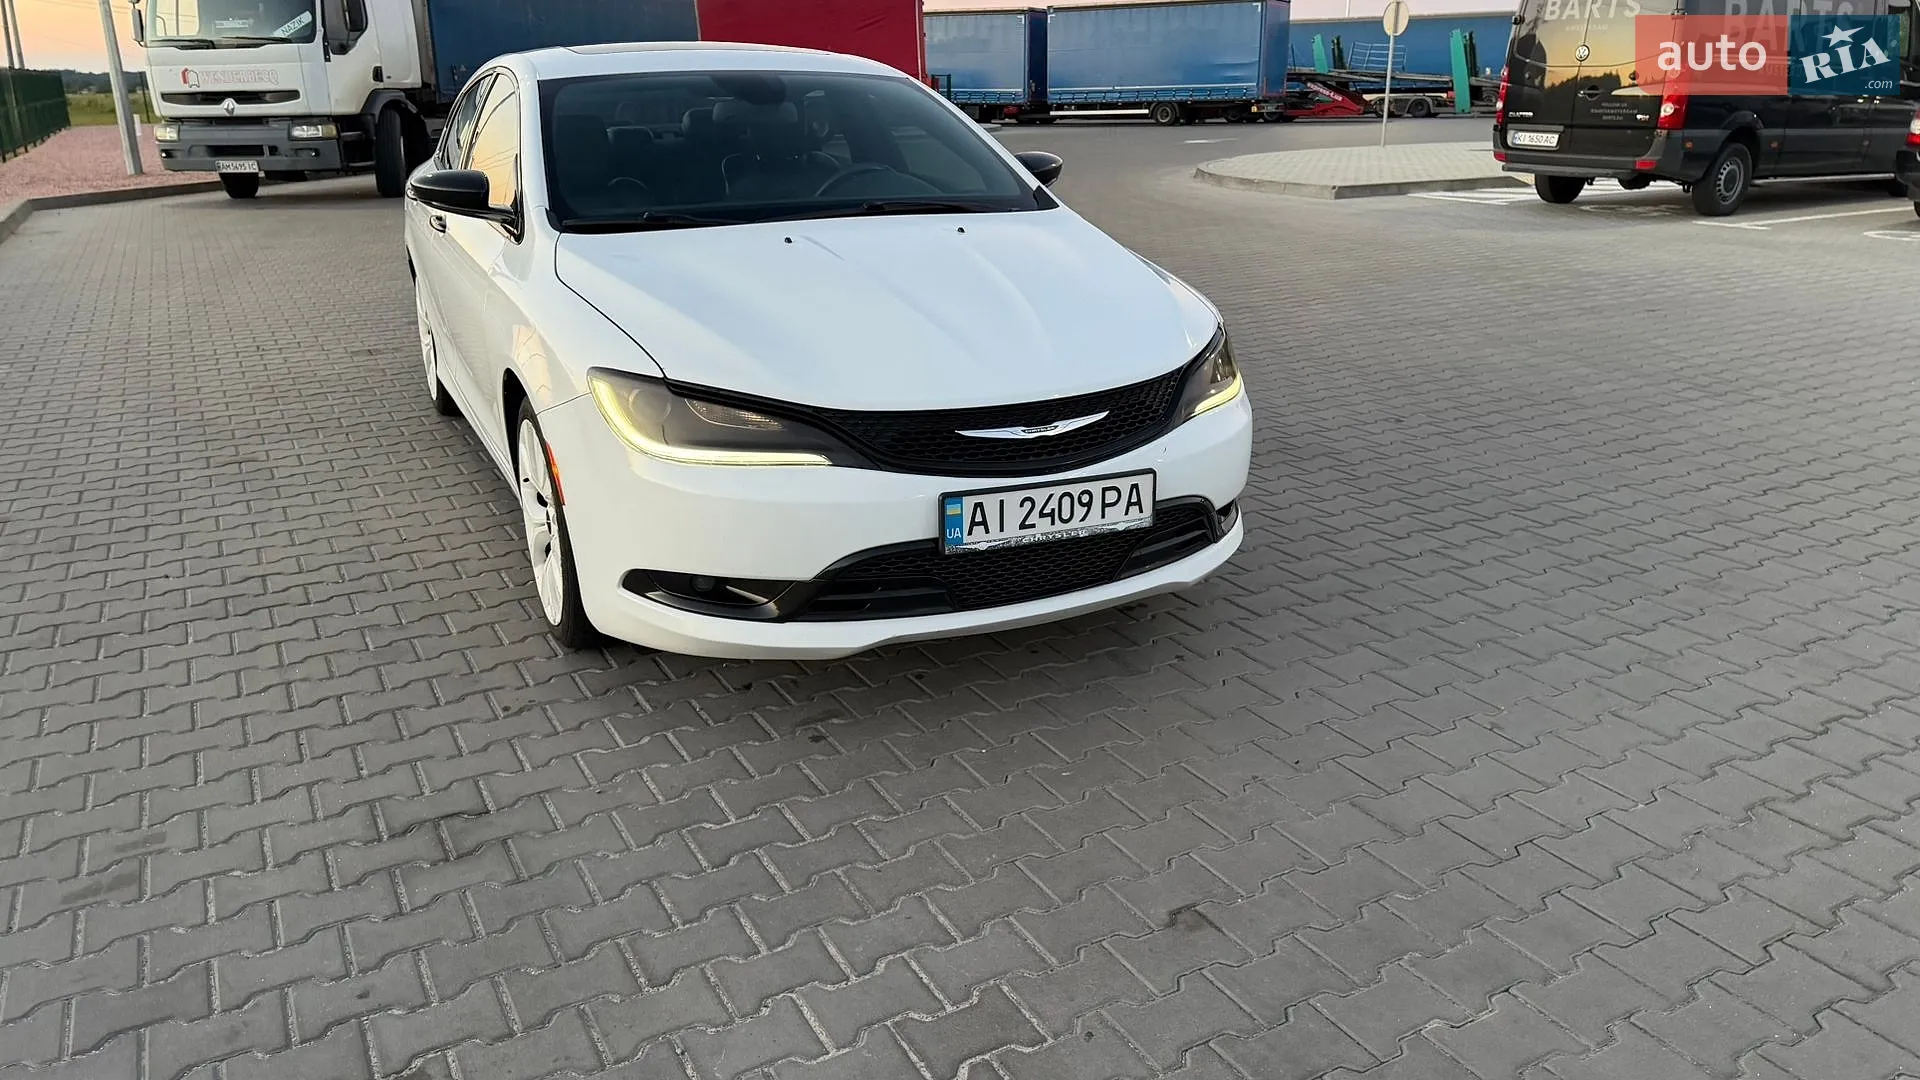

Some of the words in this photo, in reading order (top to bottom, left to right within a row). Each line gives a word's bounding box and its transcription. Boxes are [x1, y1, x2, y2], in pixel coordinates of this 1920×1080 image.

[281, 17, 304, 36] NAZIK
[946, 528, 962, 539] UA
[967, 499, 1004, 537] AI
[1018, 489, 1094, 531] 2409
[1100, 482, 1144, 519] PA
